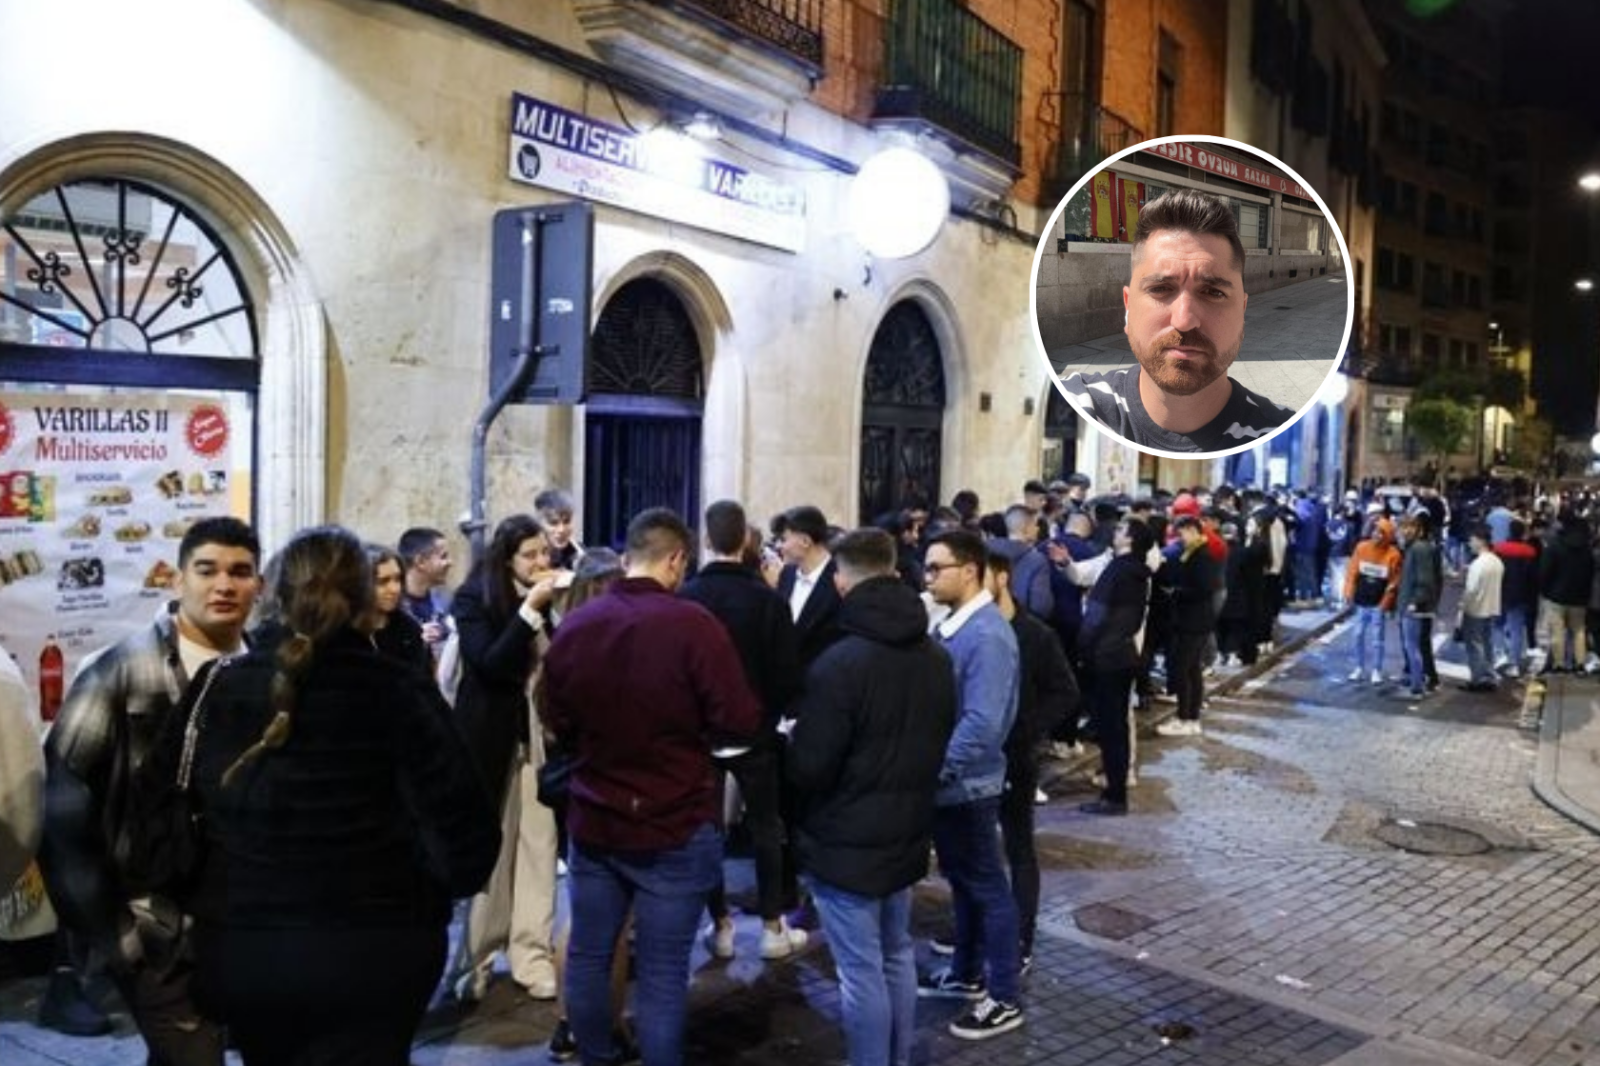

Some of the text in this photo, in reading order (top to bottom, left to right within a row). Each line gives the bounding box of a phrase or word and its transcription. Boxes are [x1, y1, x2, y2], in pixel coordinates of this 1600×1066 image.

[514, 101, 640, 169] MULTISER
[34, 406, 169, 434] VARILLAS II
[34, 436, 168, 462] Multiservicio
